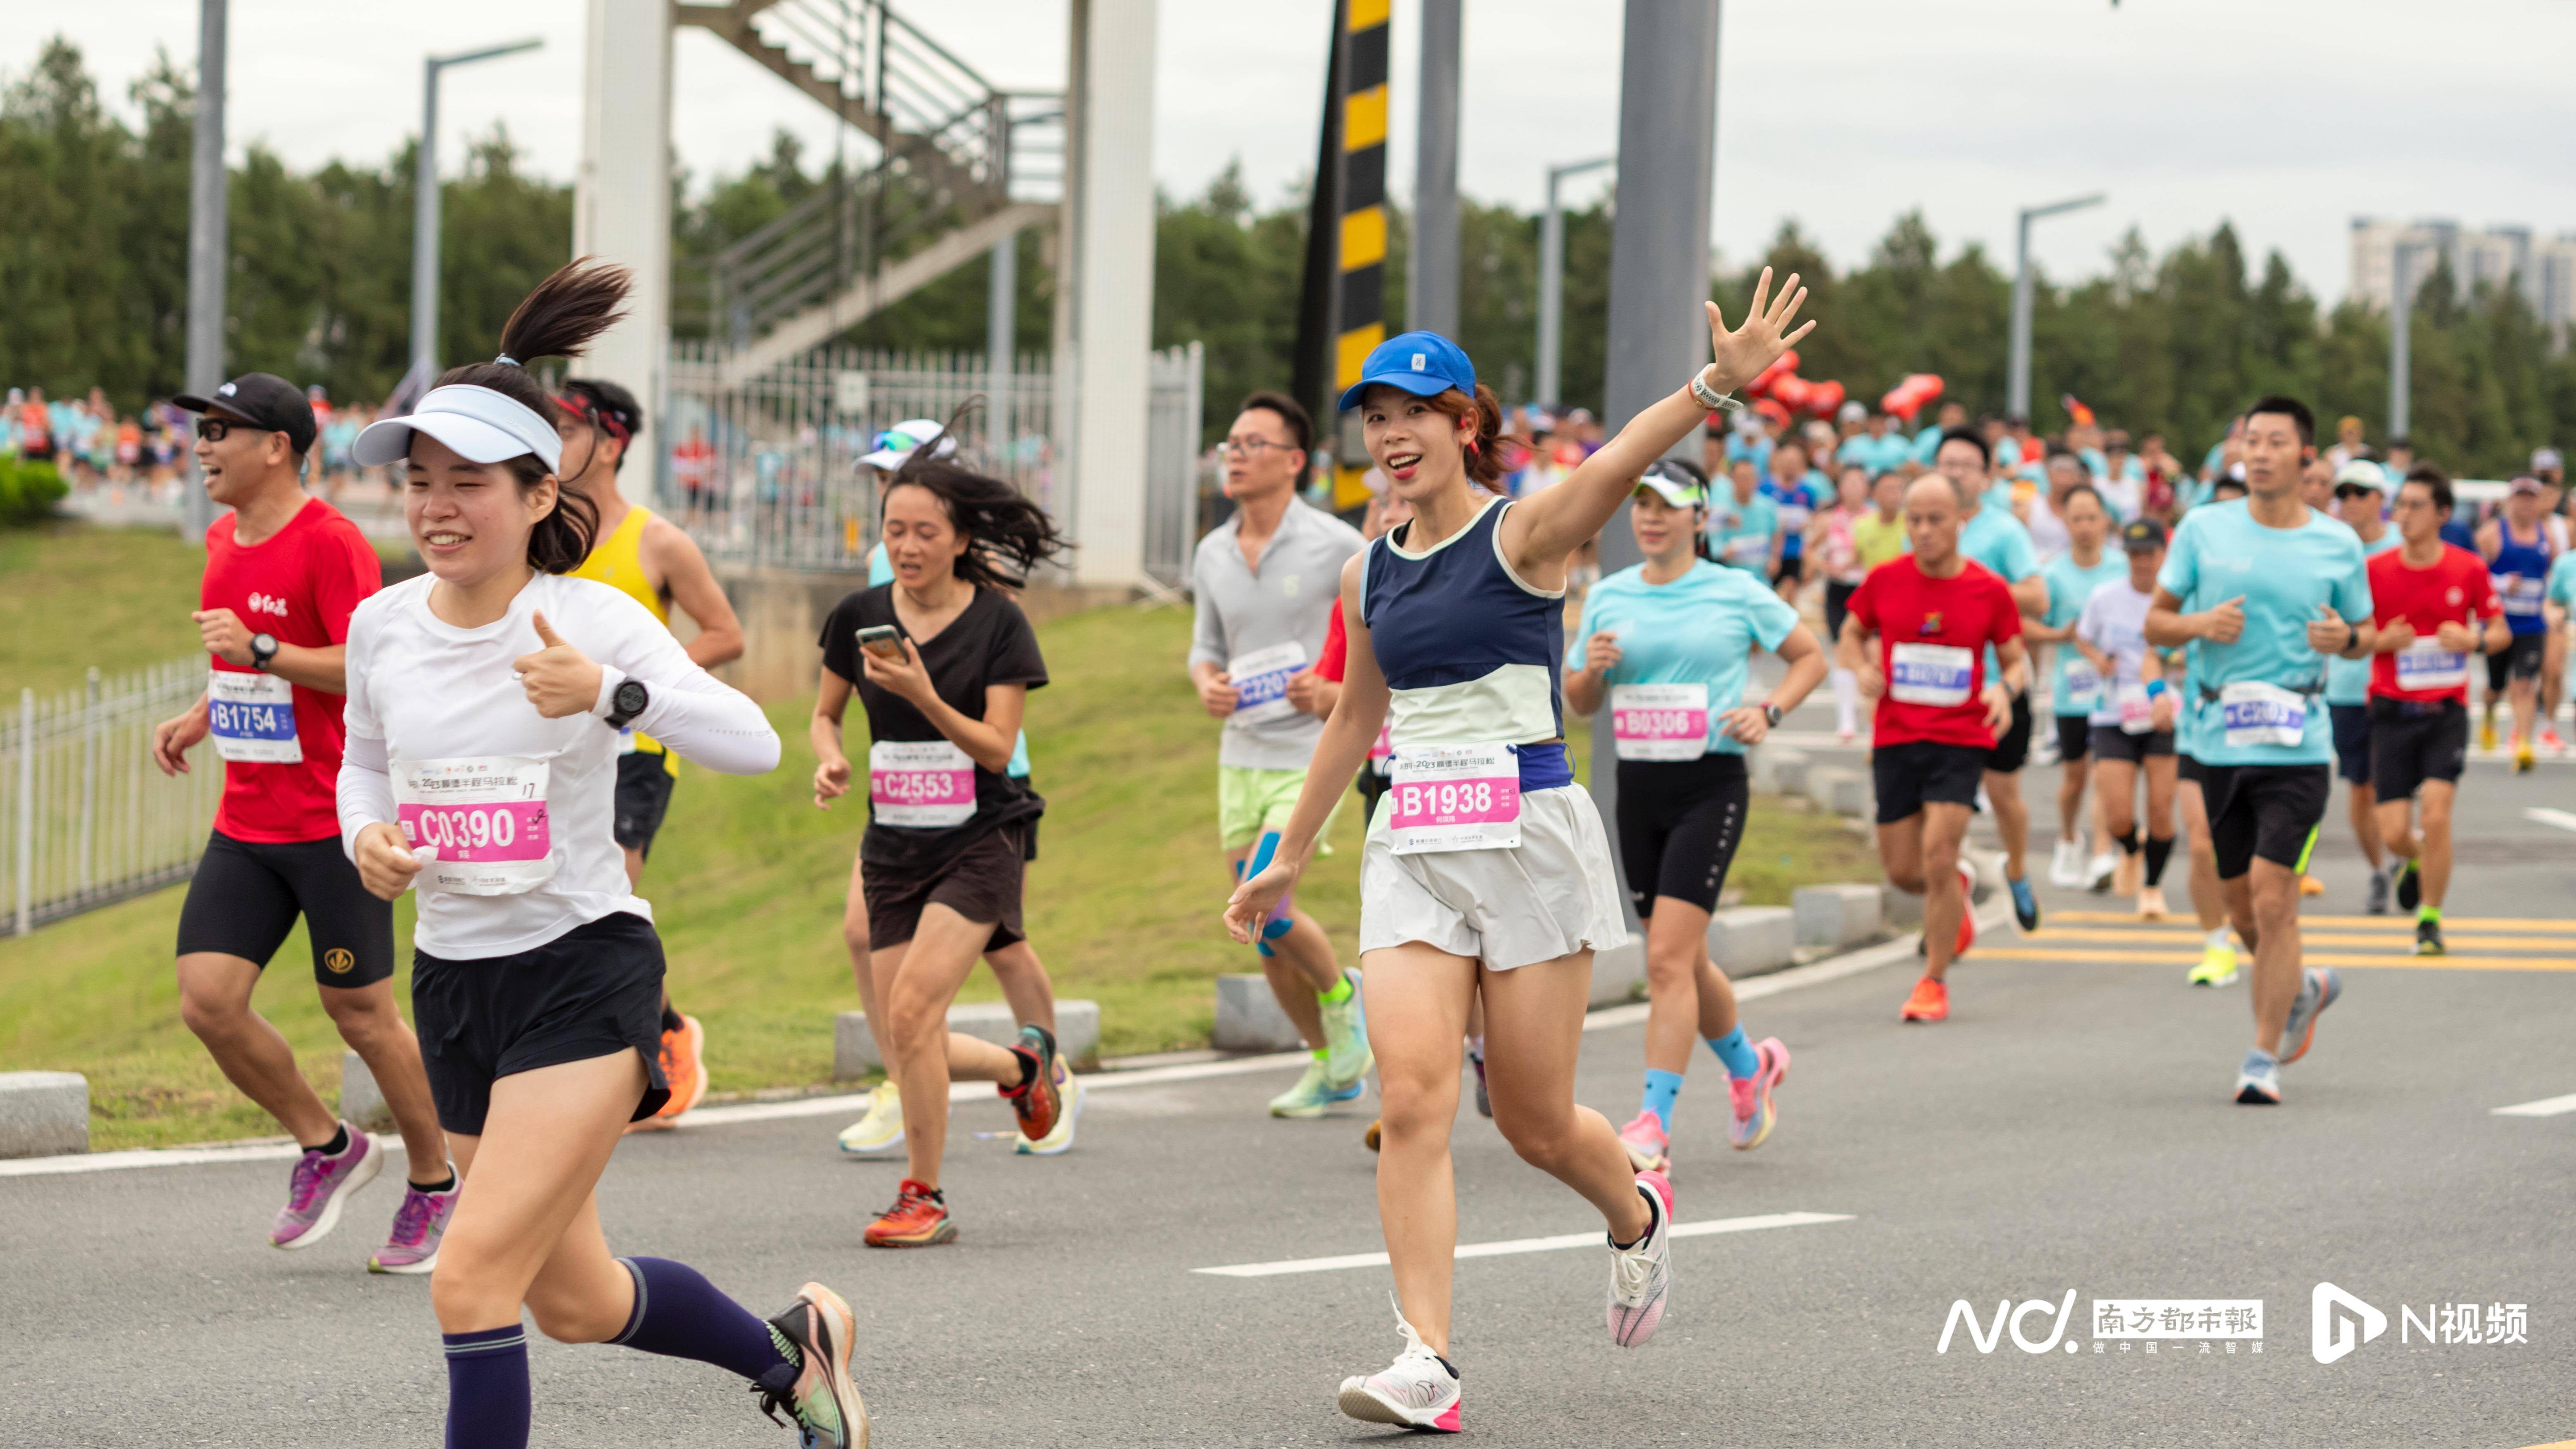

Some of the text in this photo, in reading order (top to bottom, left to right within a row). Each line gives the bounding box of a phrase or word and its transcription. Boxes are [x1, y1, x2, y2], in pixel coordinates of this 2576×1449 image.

[217, 703, 277, 733] B1754
[1626, 710, 1690, 734] B0306
[884, 772, 954, 798] C2553
[1403, 782, 1492, 816] B1938
[420, 808, 515, 848] C0390
